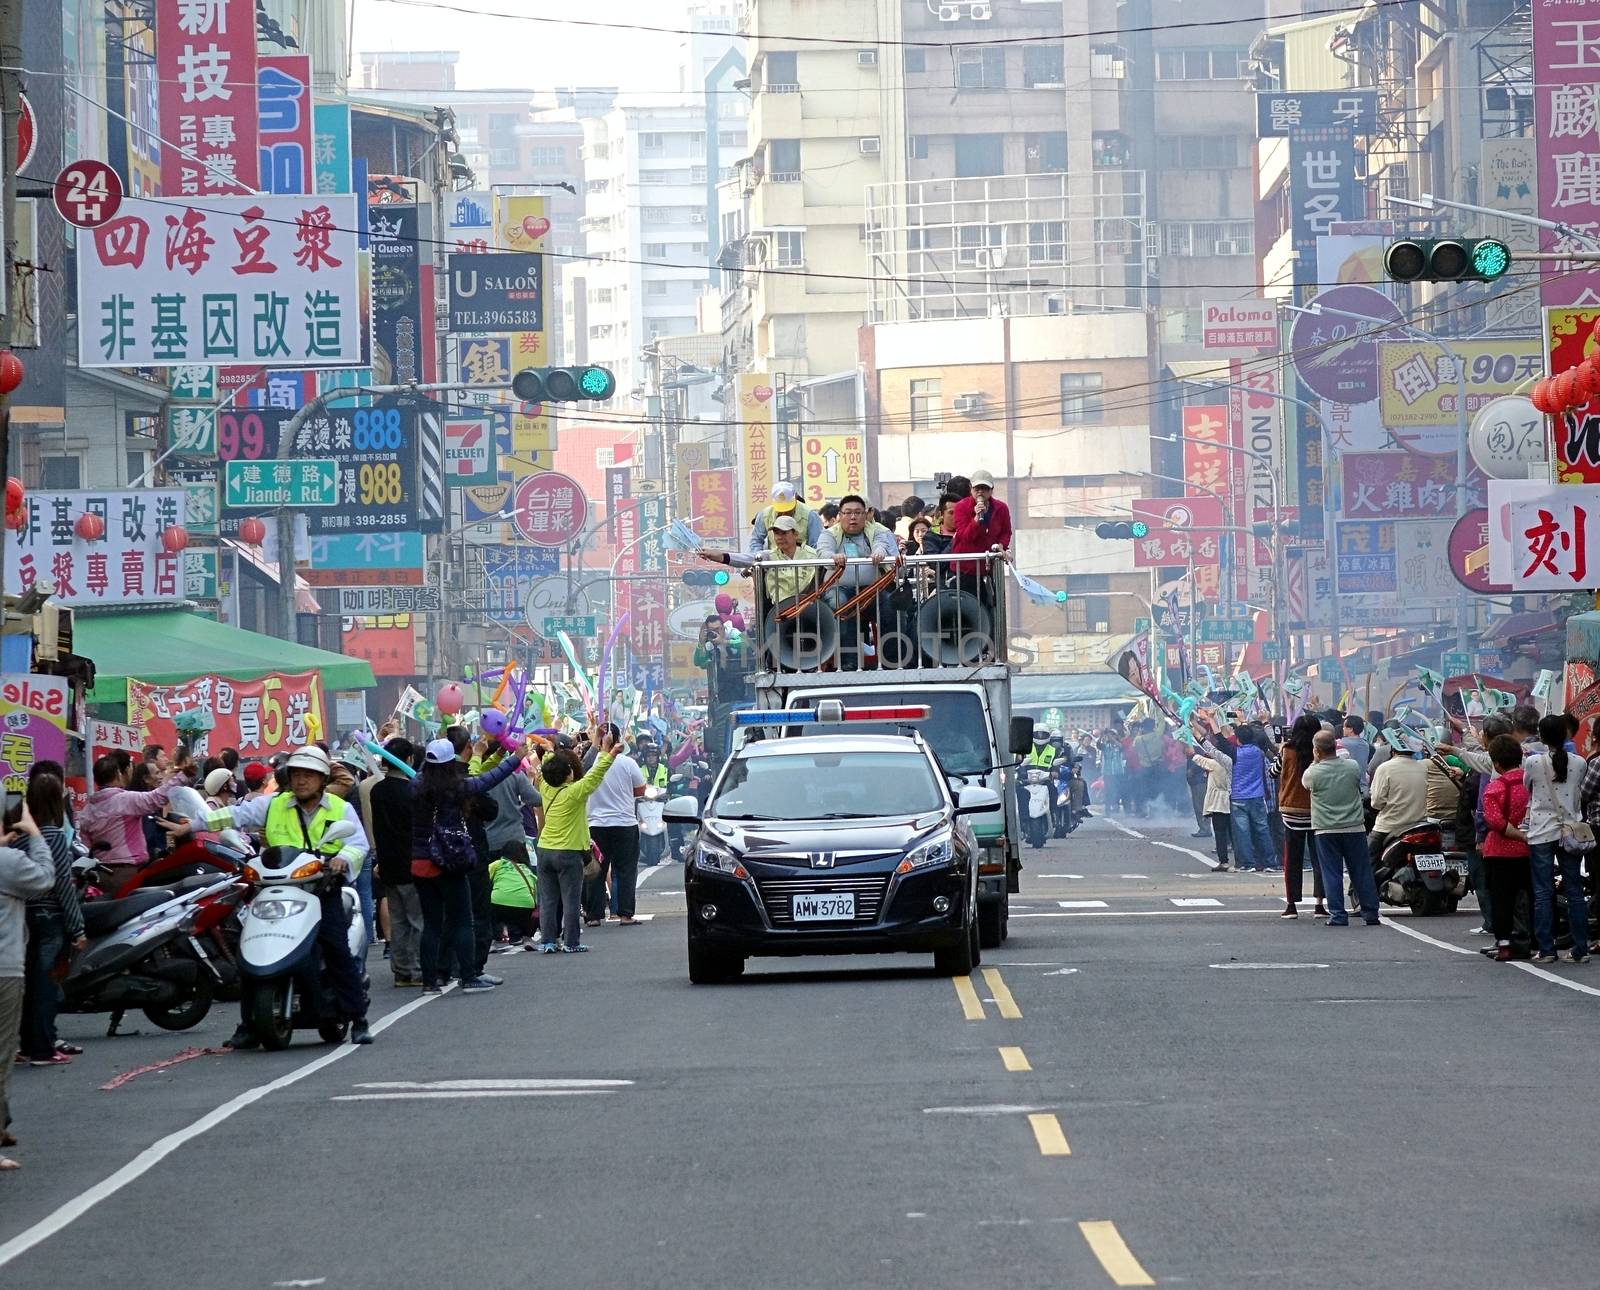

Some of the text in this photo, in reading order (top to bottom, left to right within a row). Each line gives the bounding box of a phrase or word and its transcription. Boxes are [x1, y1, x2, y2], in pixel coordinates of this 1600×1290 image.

[177, 0, 234, 103] 新技
[178, 114, 199, 197] NEW AR
[200, 114, 237, 197] 專業
[65, 170, 109, 203] 24
[1302, 150, 1343, 232] 世名
[76, 203, 101, 222] H
[95, 204, 343, 277] 四海豆漿
[377, 243, 413, 253] Queen
[455, 270, 538, 298] U SALON
[99, 289, 342, 361] 非基因改造
[454, 310, 537, 325] TEL:3965583
[1207, 306, 1273, 322] Paloma
[353, 409, 401, 450] 888
[446, 423, 482, 447] 7
[446, 447, 485, 459] ELEVEN
[749, 419, 768, 504] 公益彩券
[242, 465, 321, 484] 建德路
[360, 463, 402, 505] 988
[244, 485, 323, 502] Jiande Rd.
[528, 487, 573, 510] 台灣
[527, 511, 574, 532] 運彩
[1522, 504, 1587, 583] 刻
[18, 549, 179, 600] 豆漿專賣店
[343, 586, 440, 611] 咖啡簡餐
